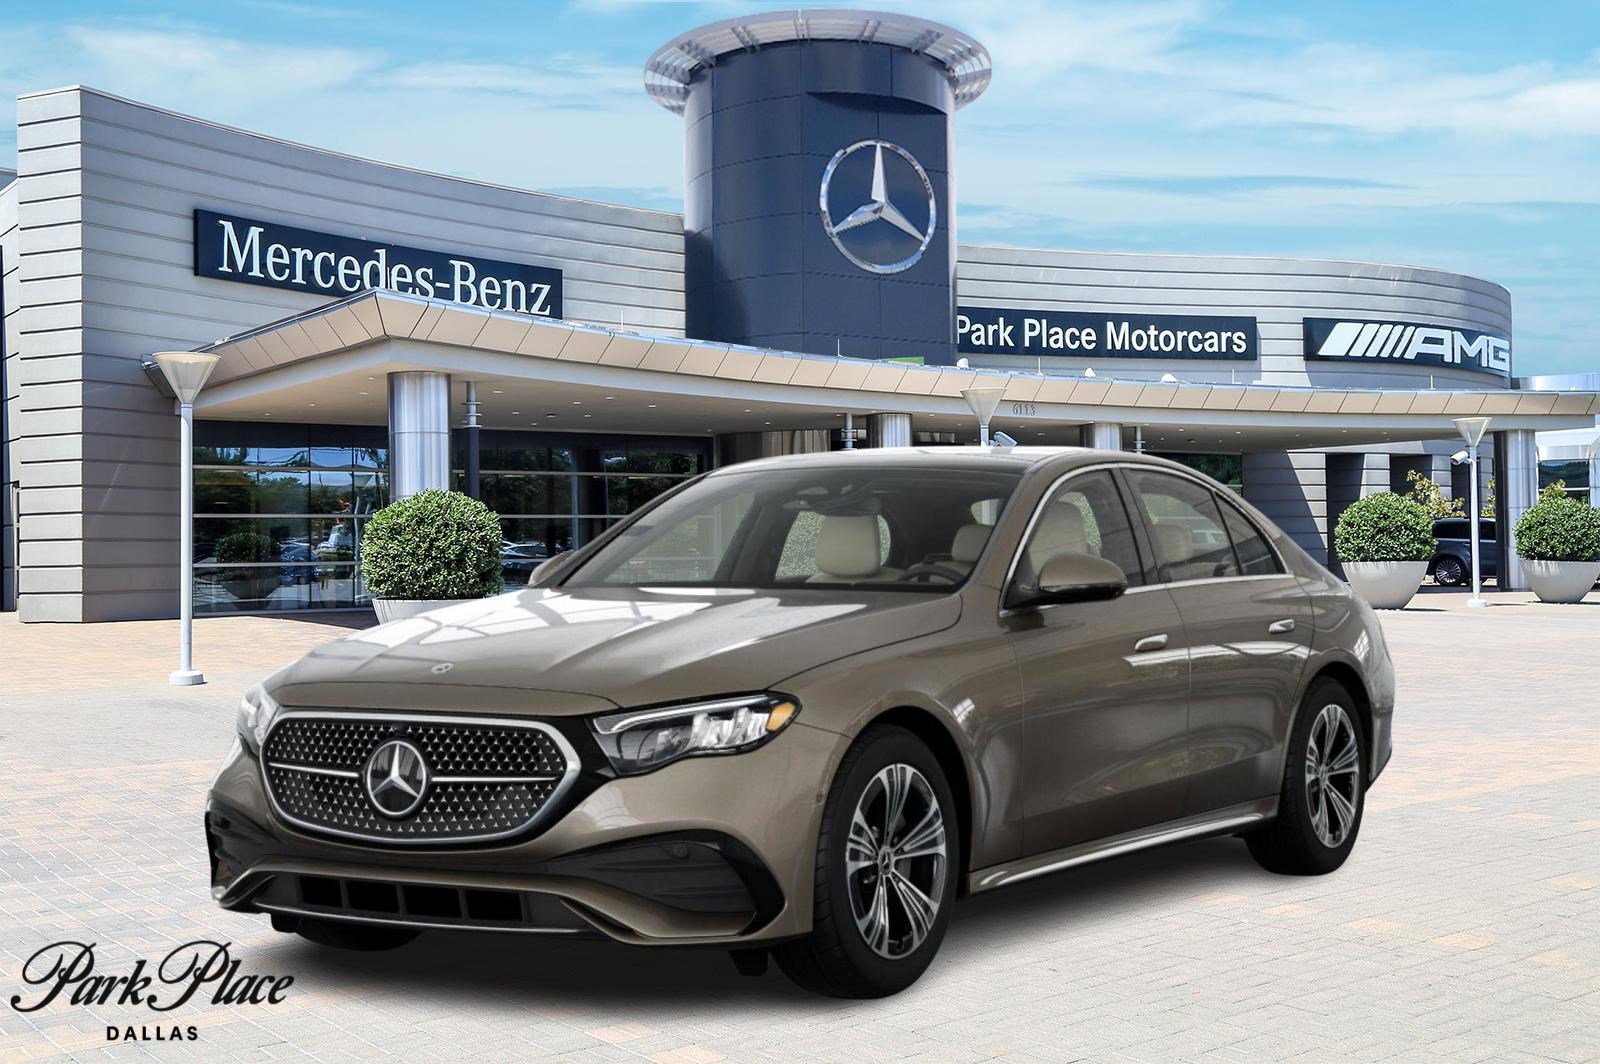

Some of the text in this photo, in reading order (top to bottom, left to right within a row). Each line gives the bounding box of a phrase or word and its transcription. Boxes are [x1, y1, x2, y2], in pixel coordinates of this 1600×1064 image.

[217, 219, 551, 316] Mercedes-Benz
[957, 315, 1247, 354] Park Place Motorcars
[1403, 326, 1510, 372] AMG
